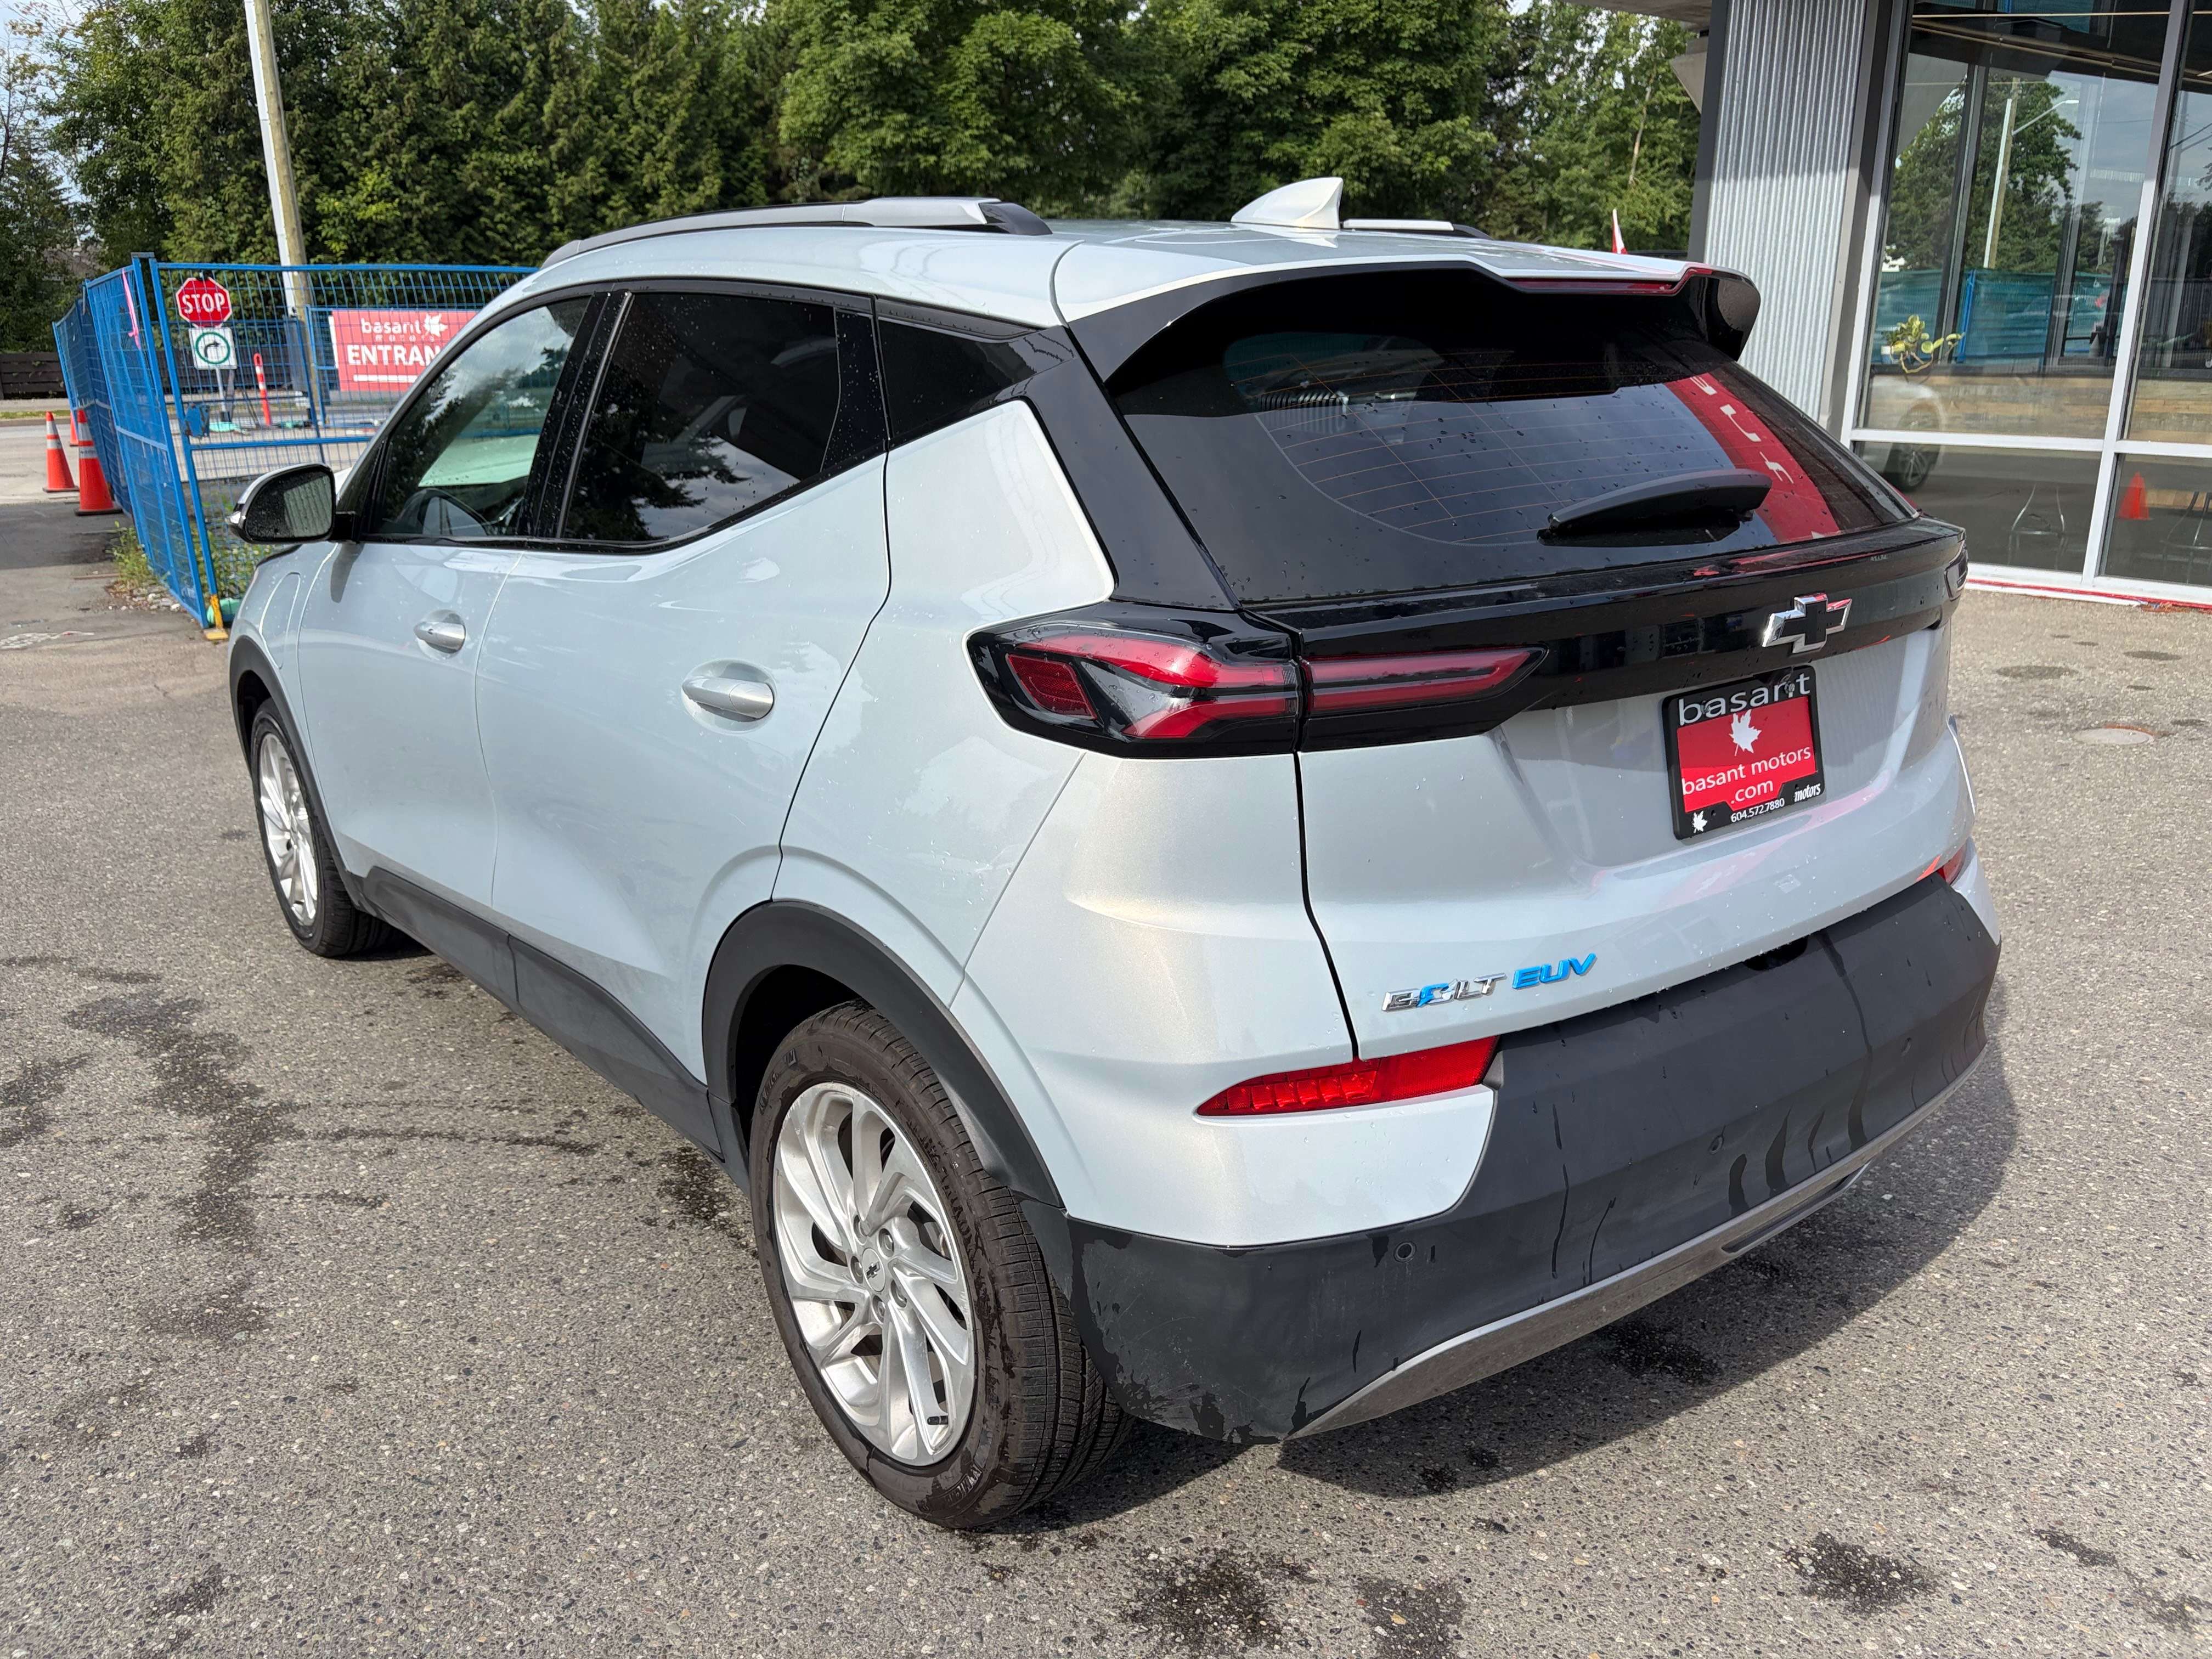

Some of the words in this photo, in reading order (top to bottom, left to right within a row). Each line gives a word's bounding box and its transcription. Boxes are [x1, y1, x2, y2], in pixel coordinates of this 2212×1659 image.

[182, 293, 225, 314] STOP
[360, 318, 422, 334] basant
[1679, 673, 1810, 725] basant
[1681, 764, 1746, 795] basant
[1751, 747, 1811, 775] motors
[1731, 780, 1773, 804] .com
[1794, 783, 1821, 802] motors
[1730, 798, 1785, 822] 604.572.7880
[1382, 973, 1508, 1011] BOLT
[1512, 953, 1596, 989] EUV
